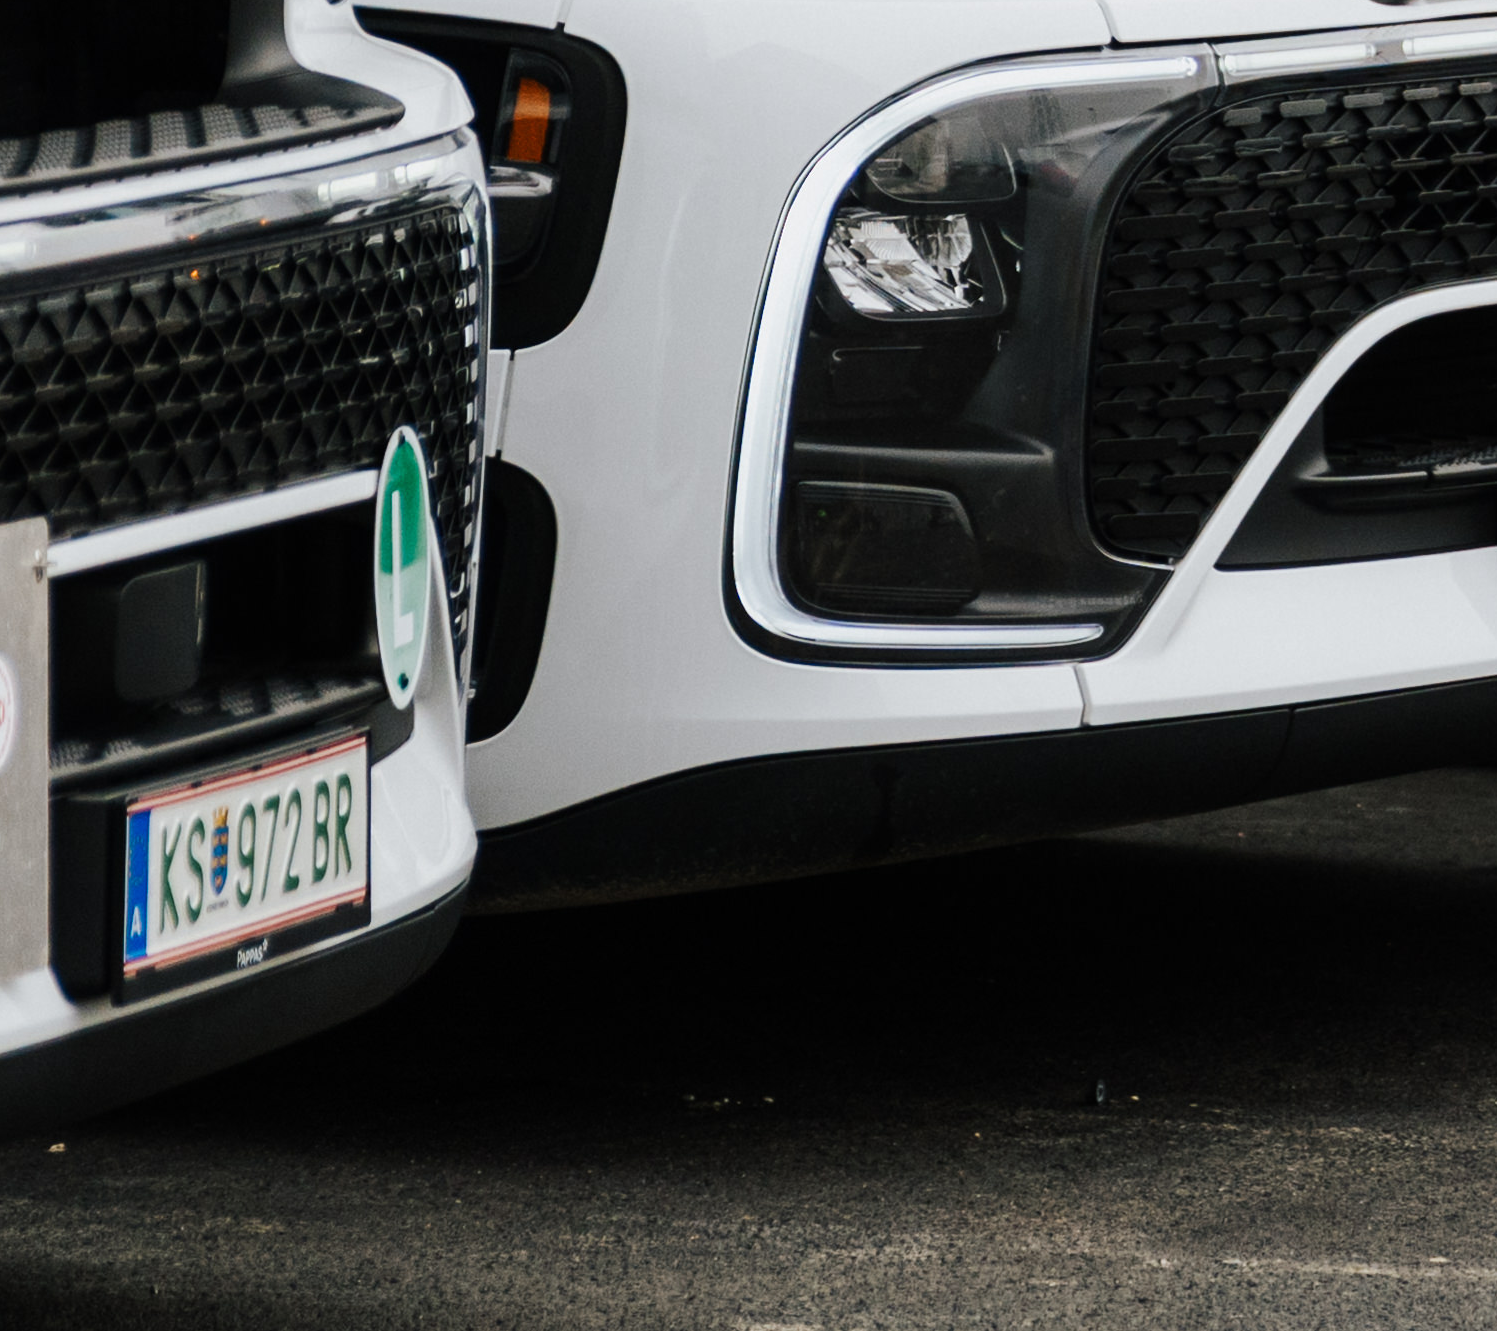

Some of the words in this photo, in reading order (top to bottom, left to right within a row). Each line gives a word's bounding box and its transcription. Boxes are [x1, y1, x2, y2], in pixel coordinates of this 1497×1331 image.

[390, 490, 414, 650] L
[130, 905, 142, 938] A
[159, 815, 206, 935] KS
[235, 787, 302, 909] 972
[310, 771, 352, 886] BR
